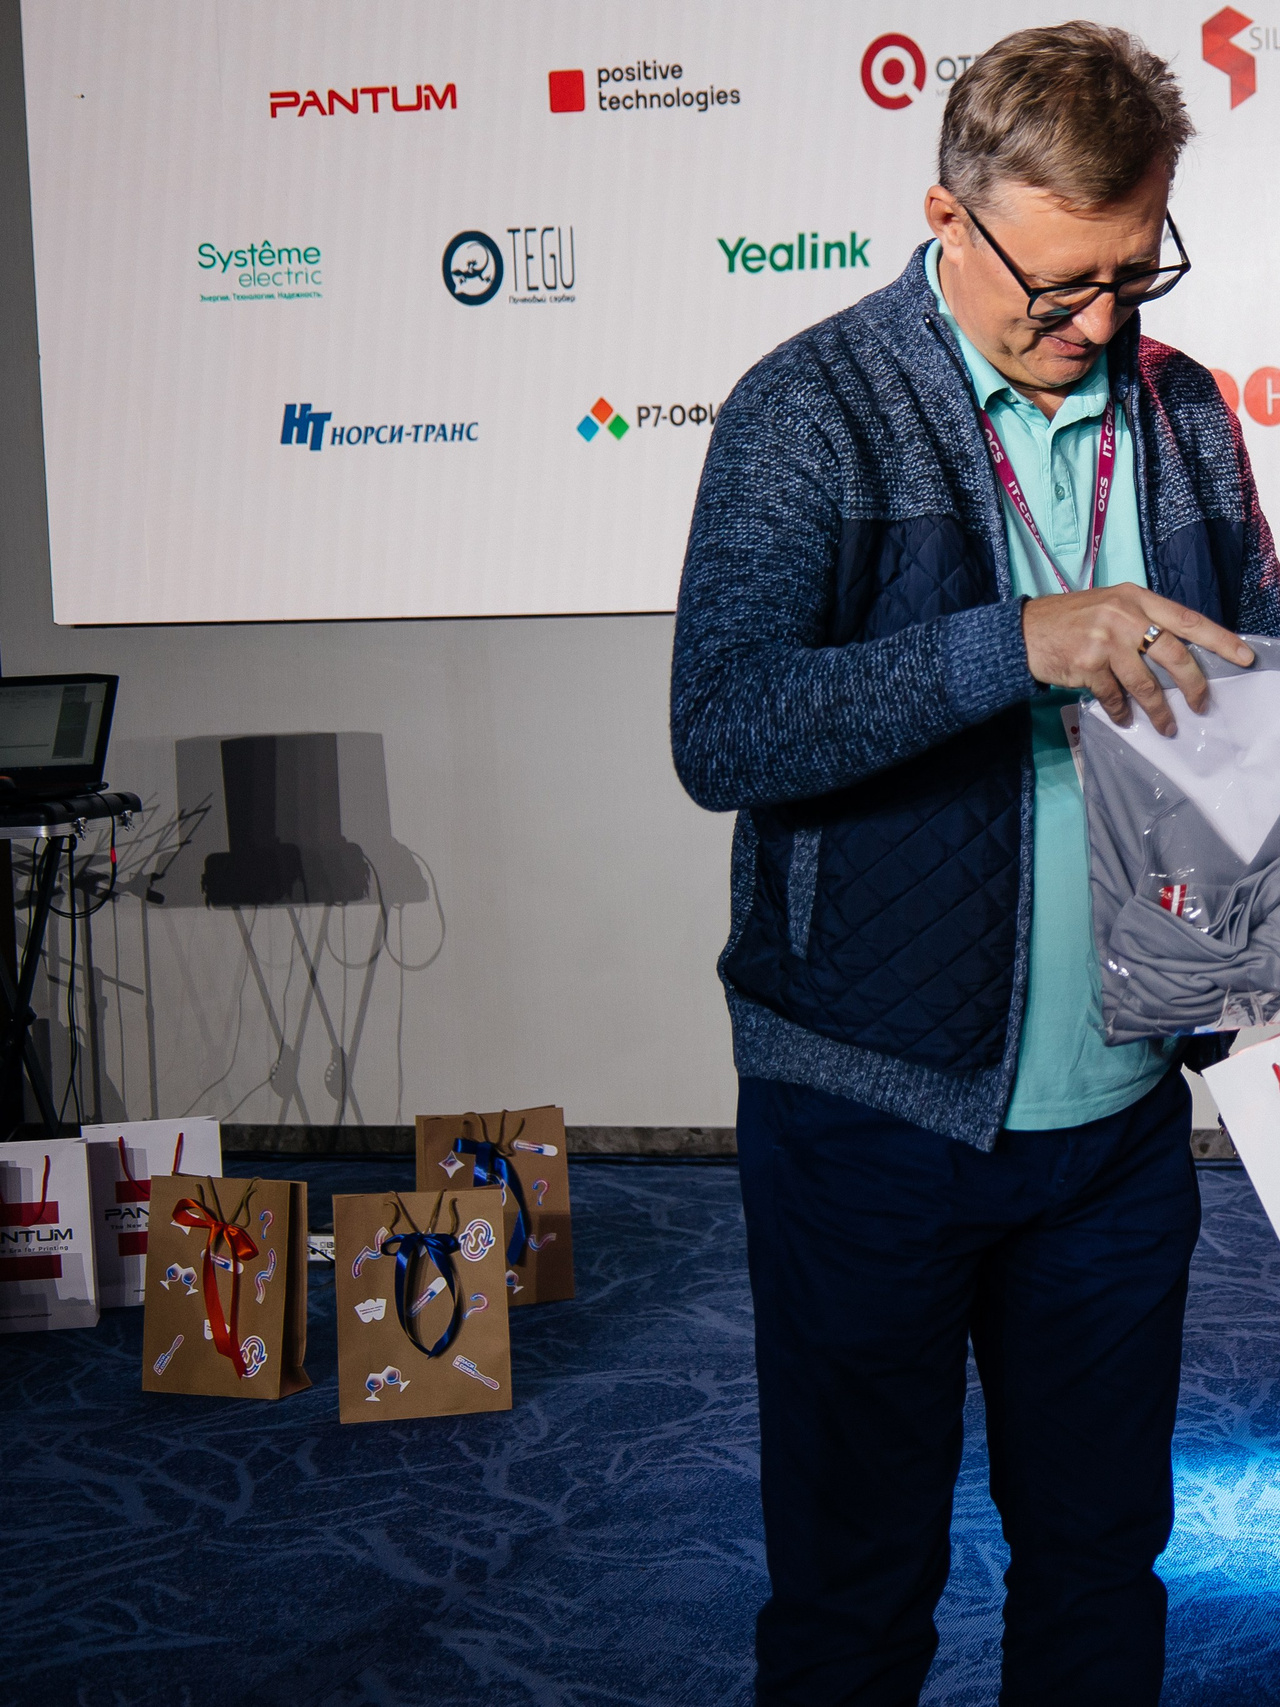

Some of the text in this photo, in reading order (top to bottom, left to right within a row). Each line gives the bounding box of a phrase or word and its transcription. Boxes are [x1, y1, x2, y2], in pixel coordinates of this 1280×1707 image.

[597, 60, 684, 89] positive
[936, 55, 982, 82] QT
[269, 82, 457, 119] PANTUM
[598, 87, 741, 112] technologies
[506, 225, 576, 292] TEGU
[717, 231, 871, 274] Yealink
[238, 264, 322, 288] electric
[636, 402, 724, 428] Р7-ОФИ
[330, 420, 479, 446] НОРСИ-ТРАНС
[1097, 475, 1109, 513] OCS
[0, 1228, 73, 1244] NTUM
